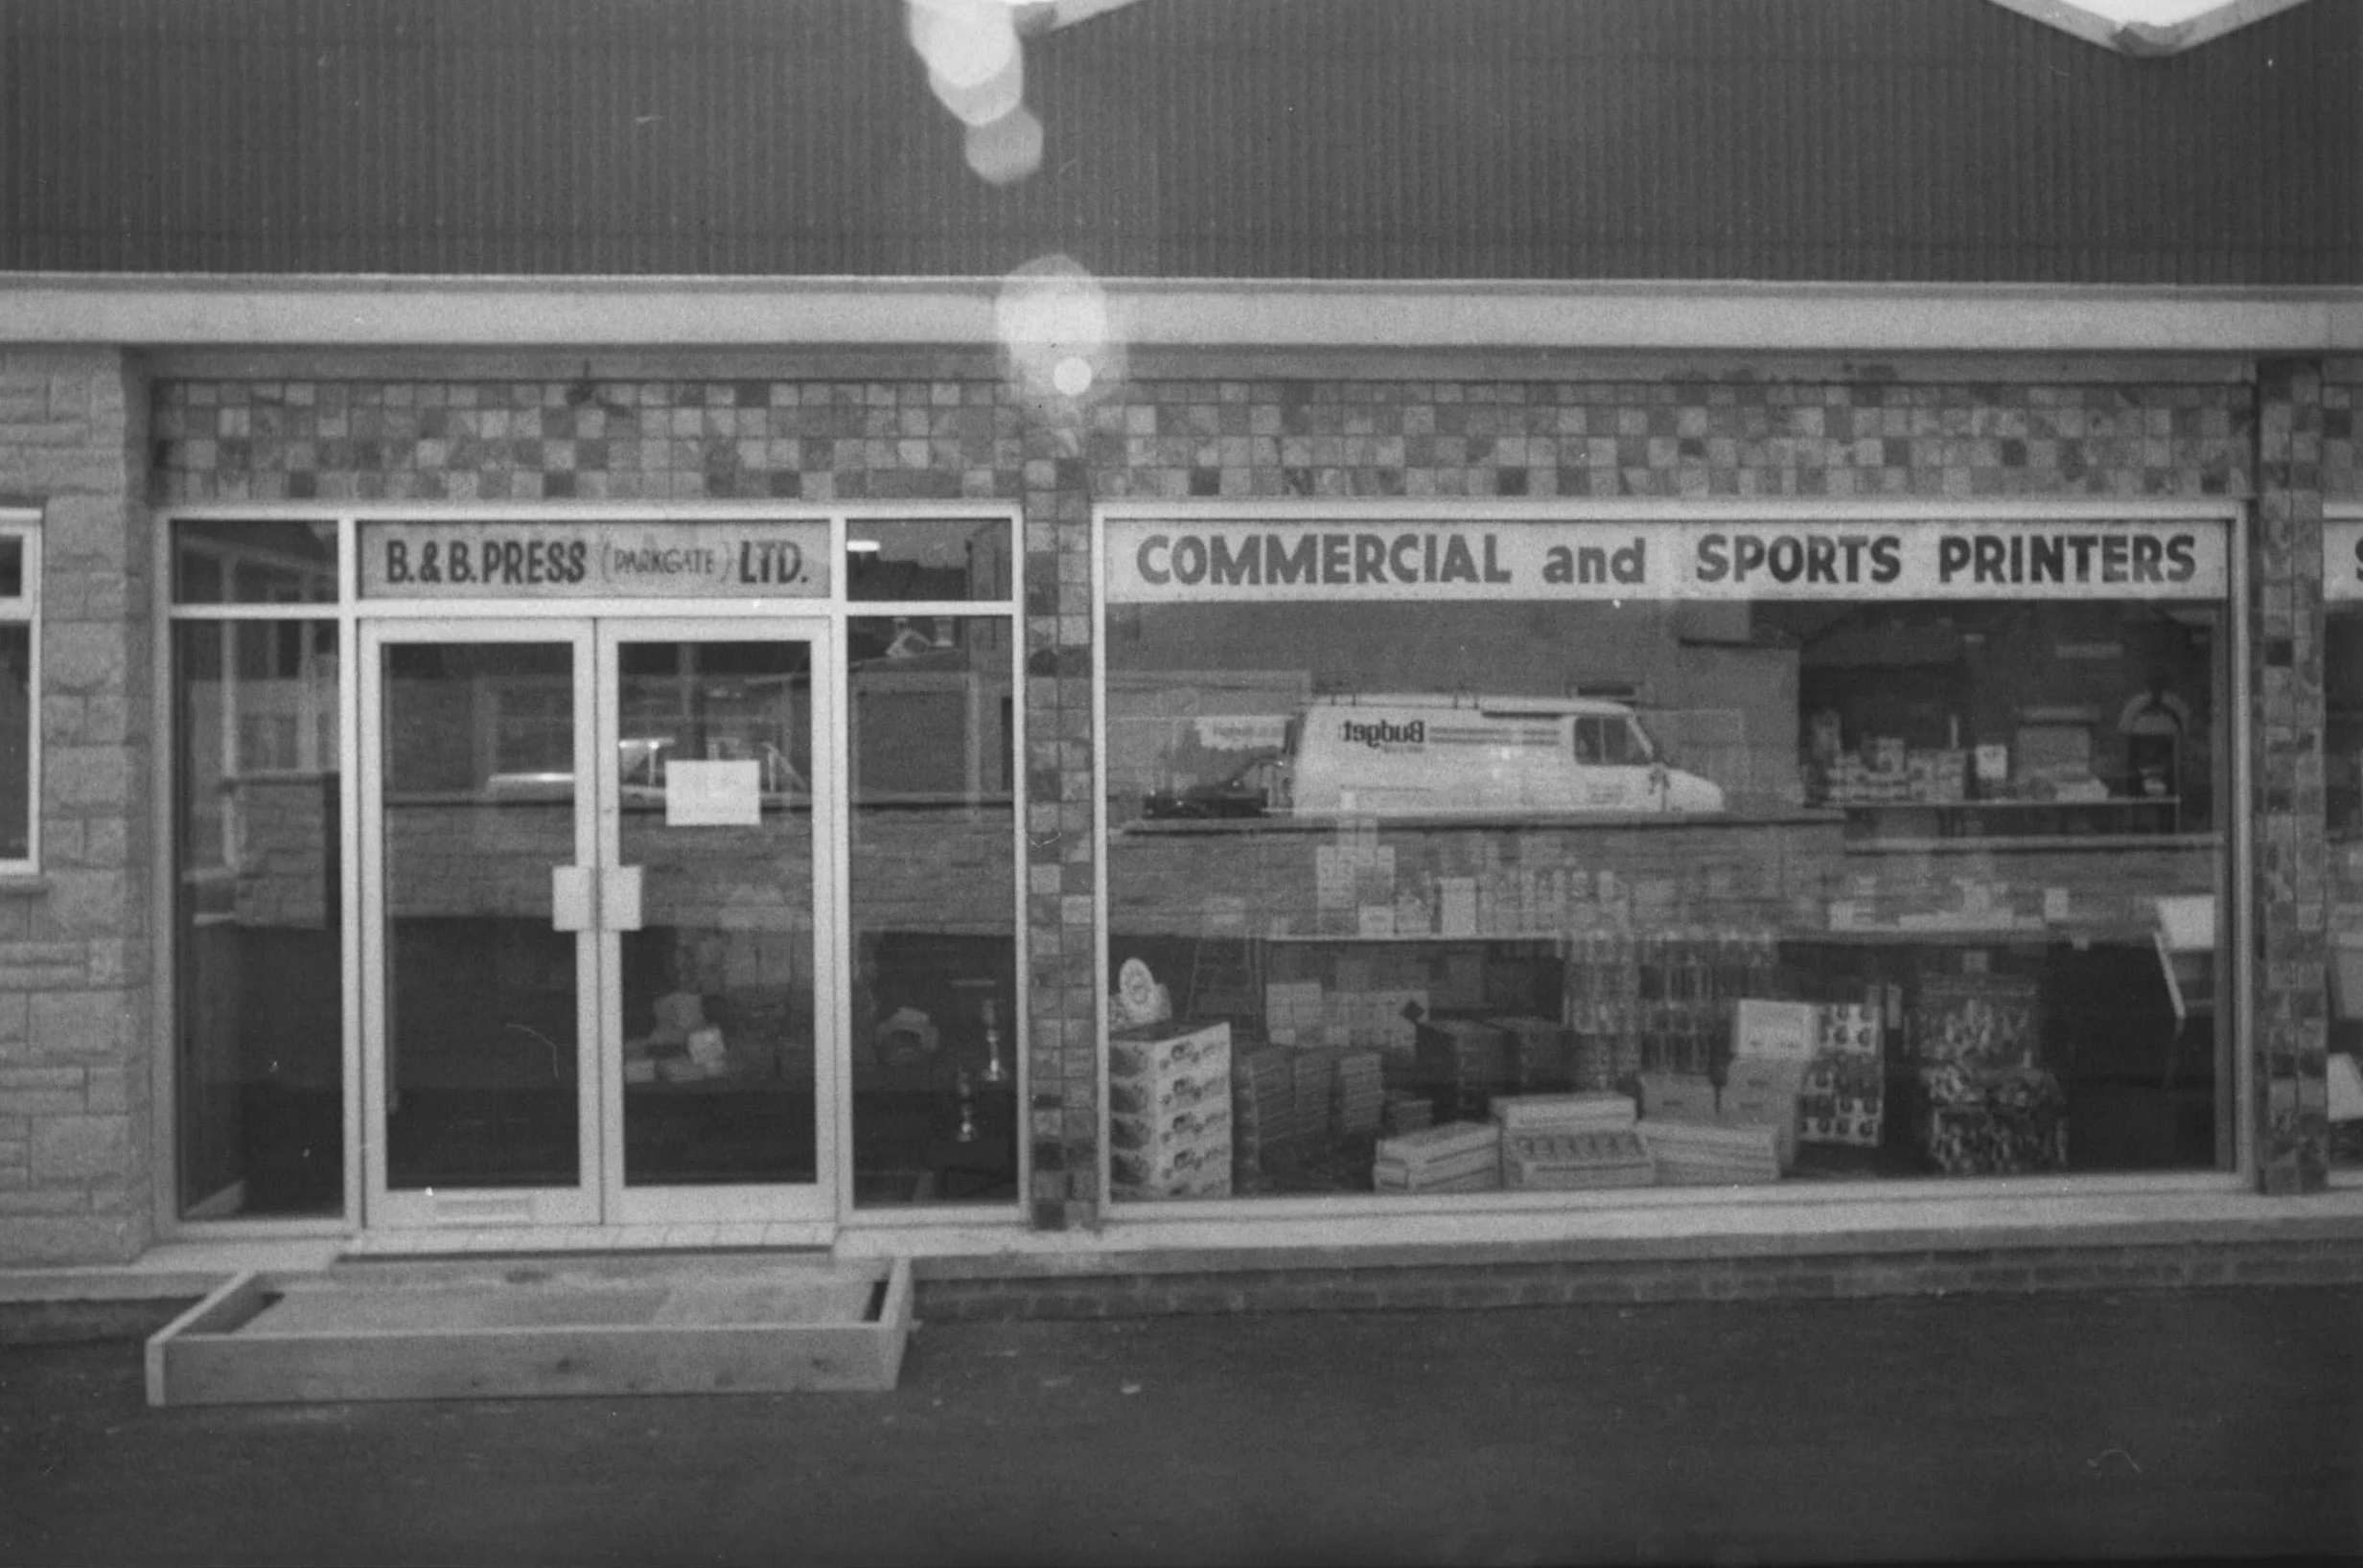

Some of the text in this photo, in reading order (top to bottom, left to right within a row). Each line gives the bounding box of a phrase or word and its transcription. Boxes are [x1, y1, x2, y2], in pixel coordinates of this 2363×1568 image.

[739, 540, 808, 584] LTD.
[1136, 534, 2196, 586] COMMERCIAL and SPORTS PRINTERS
